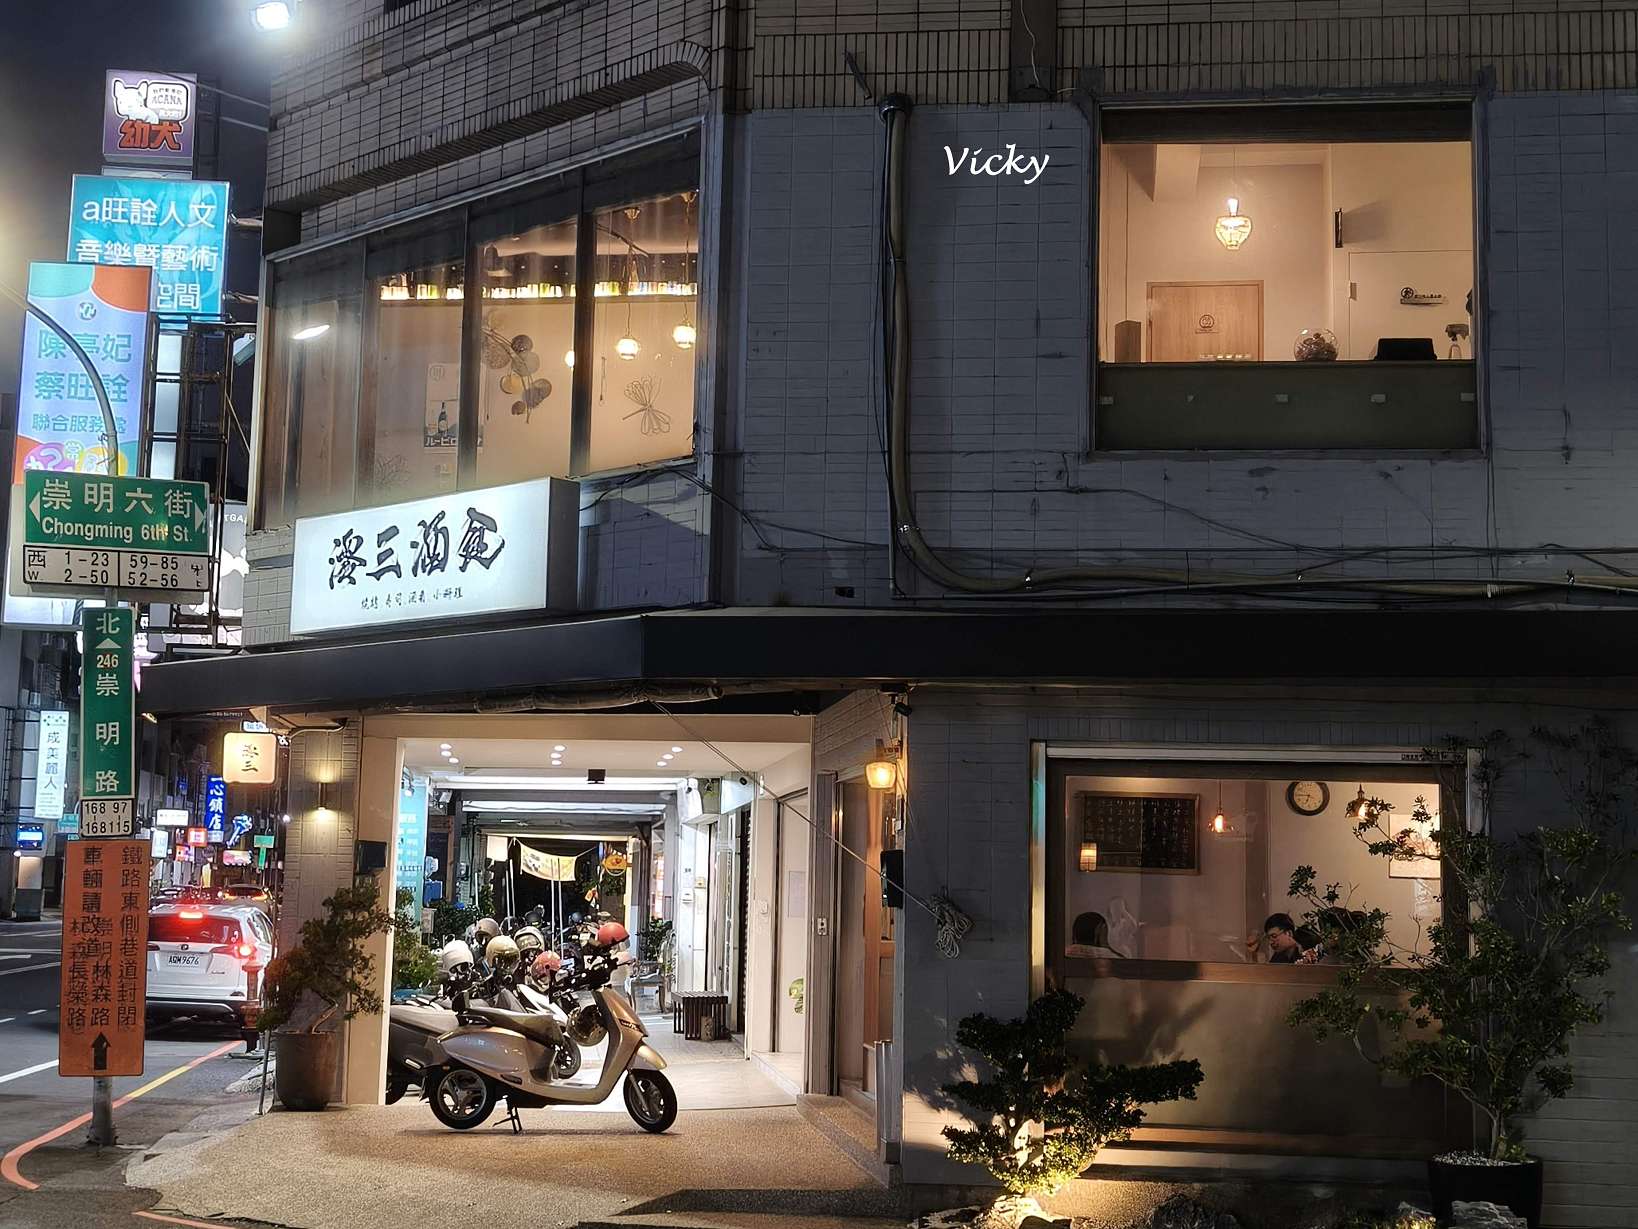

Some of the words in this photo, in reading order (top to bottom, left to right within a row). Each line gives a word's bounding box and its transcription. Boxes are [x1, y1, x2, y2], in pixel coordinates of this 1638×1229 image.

[152, 94, 182, 105] ACANA
[119, 119, 183, 151] 幼犬
[82, 197, 217, 229] a旺詮人文
[42, 478, 194, 519] 崇明六街
[41, 516, 133, 542] Chongming
[141, 523, 169, 542] 6th
[173, 526, 193, 542] St.
[27, 550, 47, 568] 西
[129, 555, 179, 570] 59-85
[127, 573, 179, 587] 52-56
[96, 613, 121, 634] 北
[96, 654, 119, 669] 246
[95, 673, 120, 794] 崇明路
[84, 802, 106, 815] 168
[112, 801, 128, 813] 97
[108, 820, 131, 834] 115
